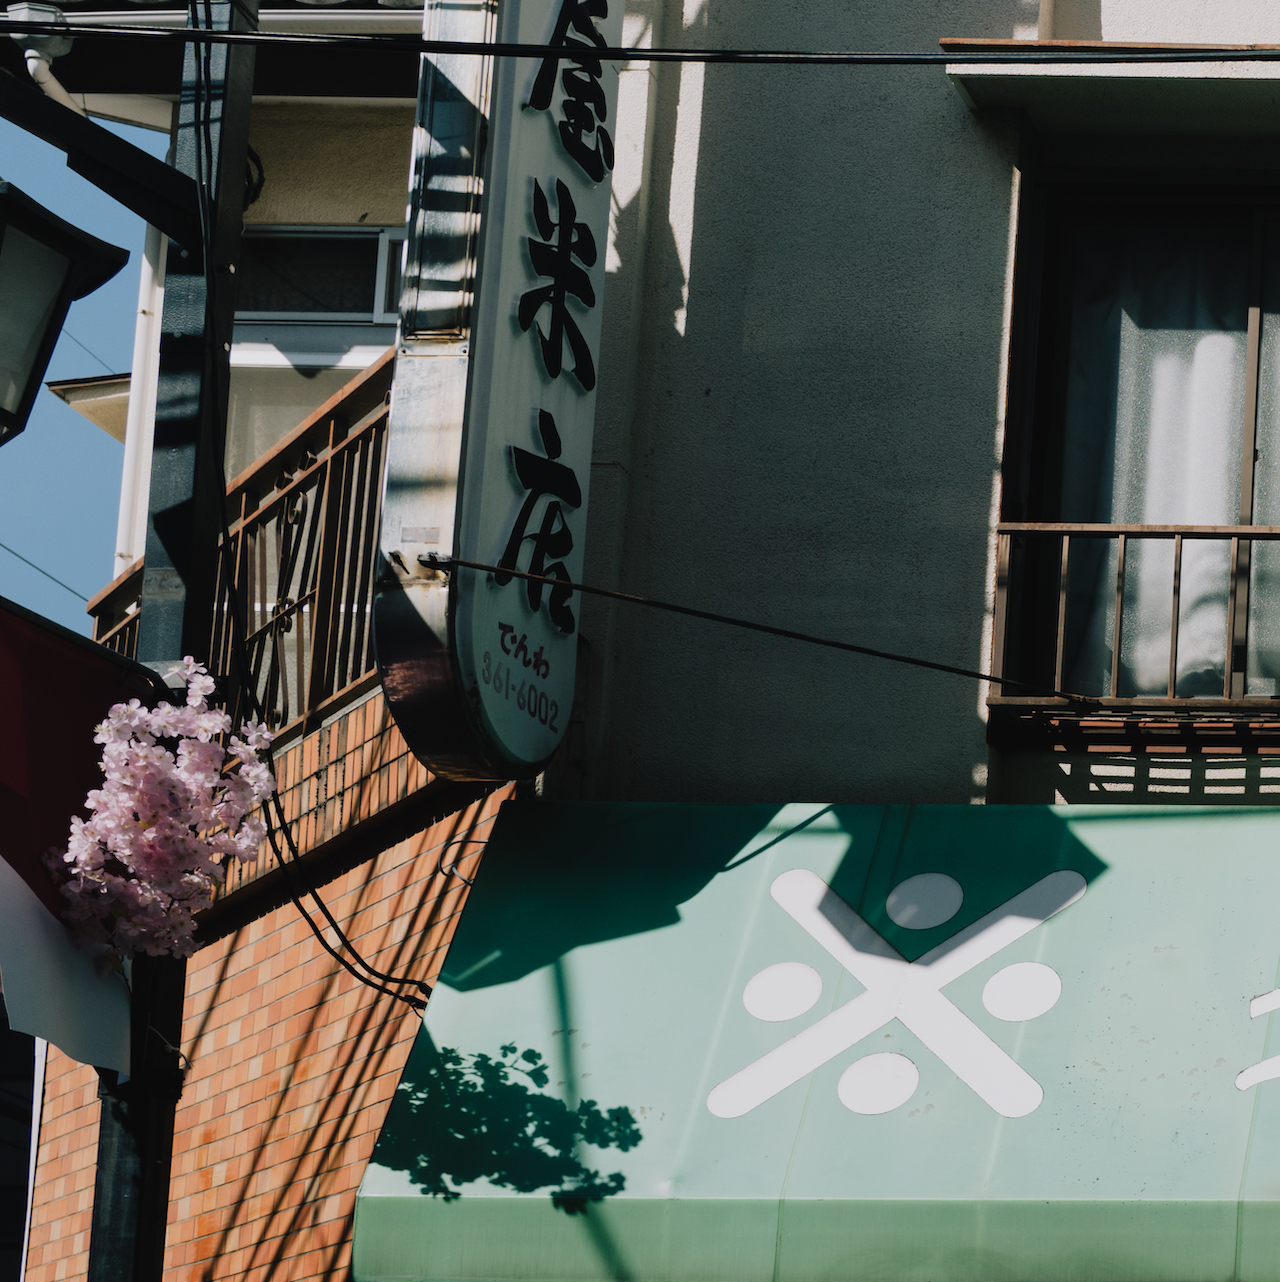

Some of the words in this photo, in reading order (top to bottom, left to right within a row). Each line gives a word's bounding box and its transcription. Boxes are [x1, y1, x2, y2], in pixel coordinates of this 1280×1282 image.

[498, 621, 550, 680] でんわ
[482, 651, 559, 734] 361-6002
